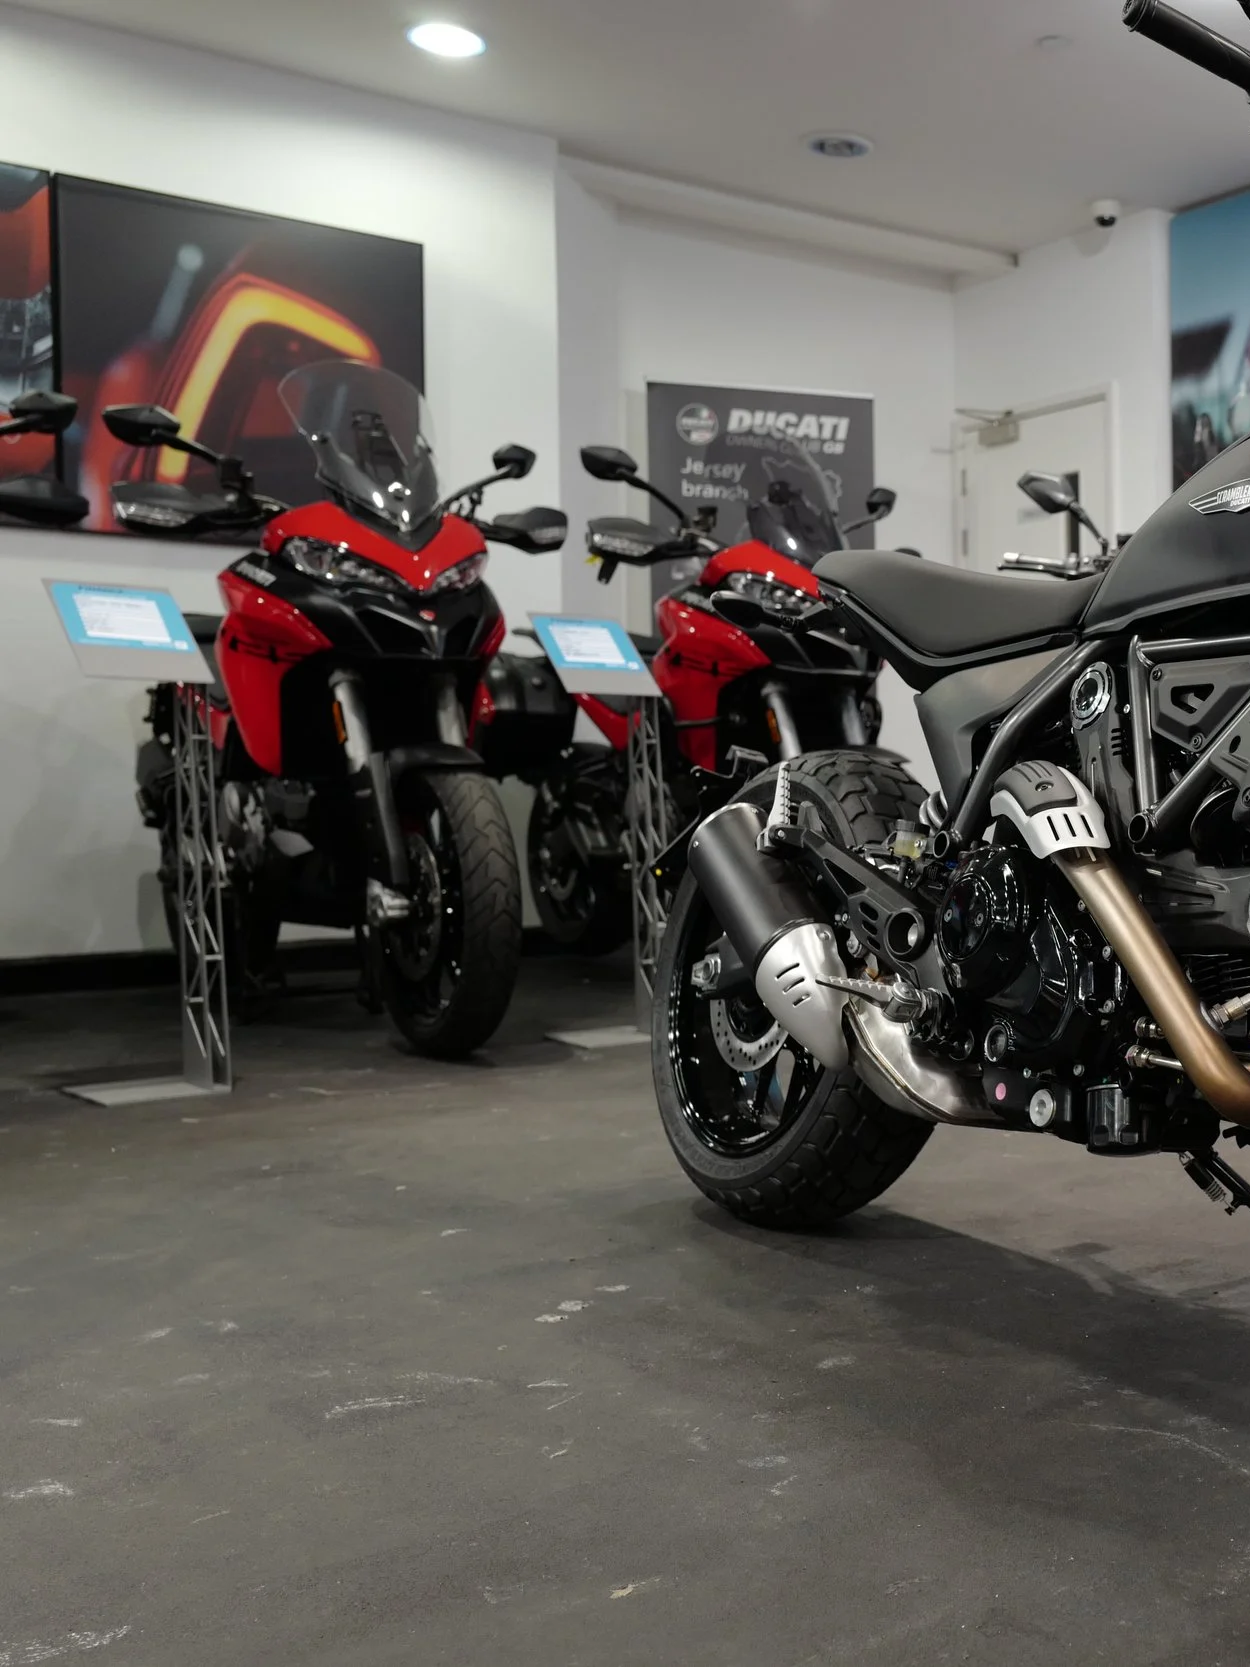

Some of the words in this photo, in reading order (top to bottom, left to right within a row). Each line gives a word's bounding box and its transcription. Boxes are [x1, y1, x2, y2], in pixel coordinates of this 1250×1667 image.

[727, 408, 850, 440] DUCATI
[680, 456, 747, 483] Jersey
[681, 479, 749, 500] branch
[1229, 497, 1250, 507] DUCATI
